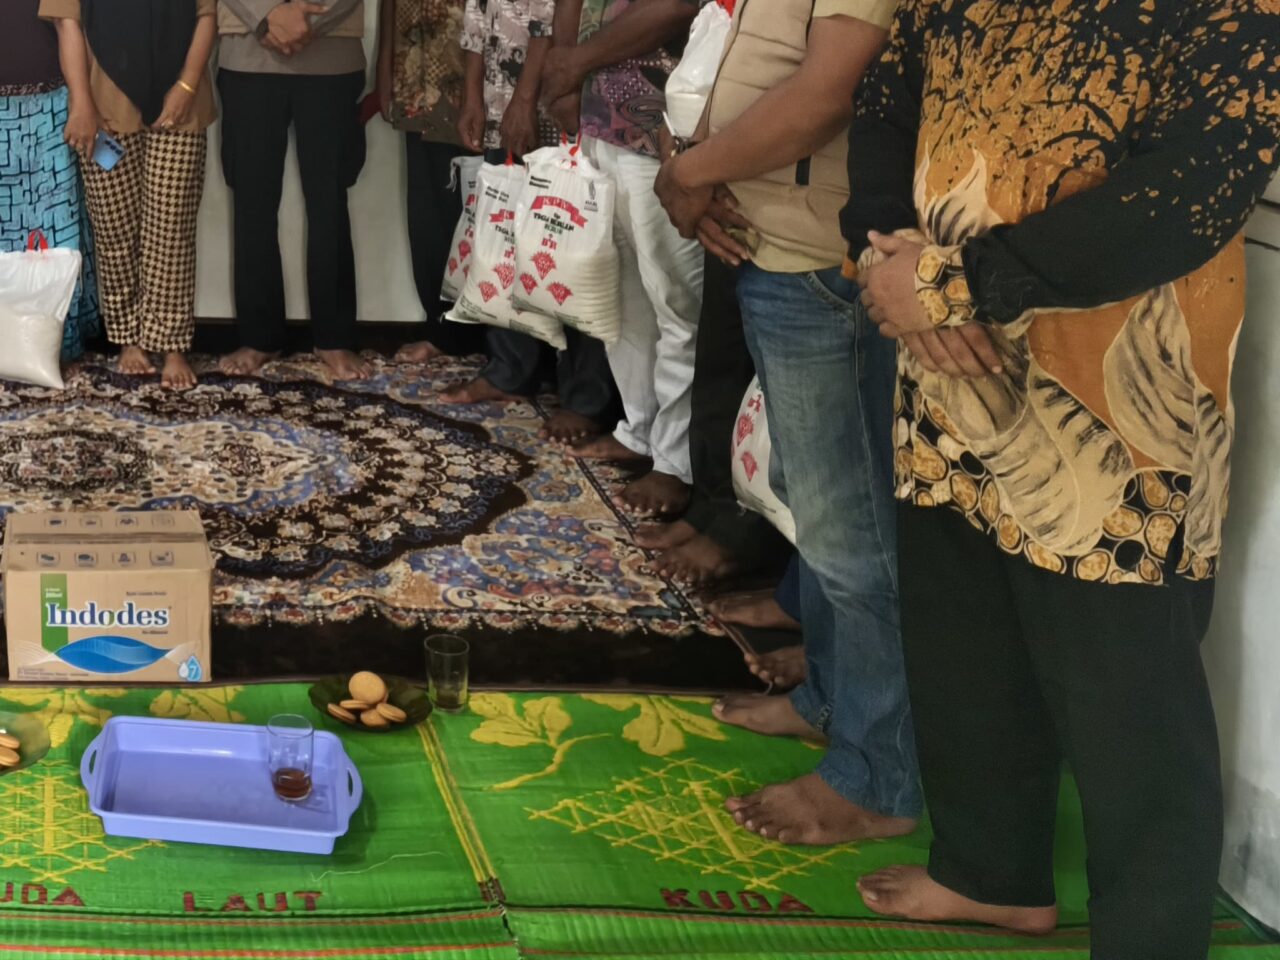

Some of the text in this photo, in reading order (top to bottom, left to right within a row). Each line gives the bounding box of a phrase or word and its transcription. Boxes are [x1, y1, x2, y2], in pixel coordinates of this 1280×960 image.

[46, 601, 168, 627] Indodes
[182, 890, 323, 913] LAUT
[659, 888, 816, 914] KUDA
